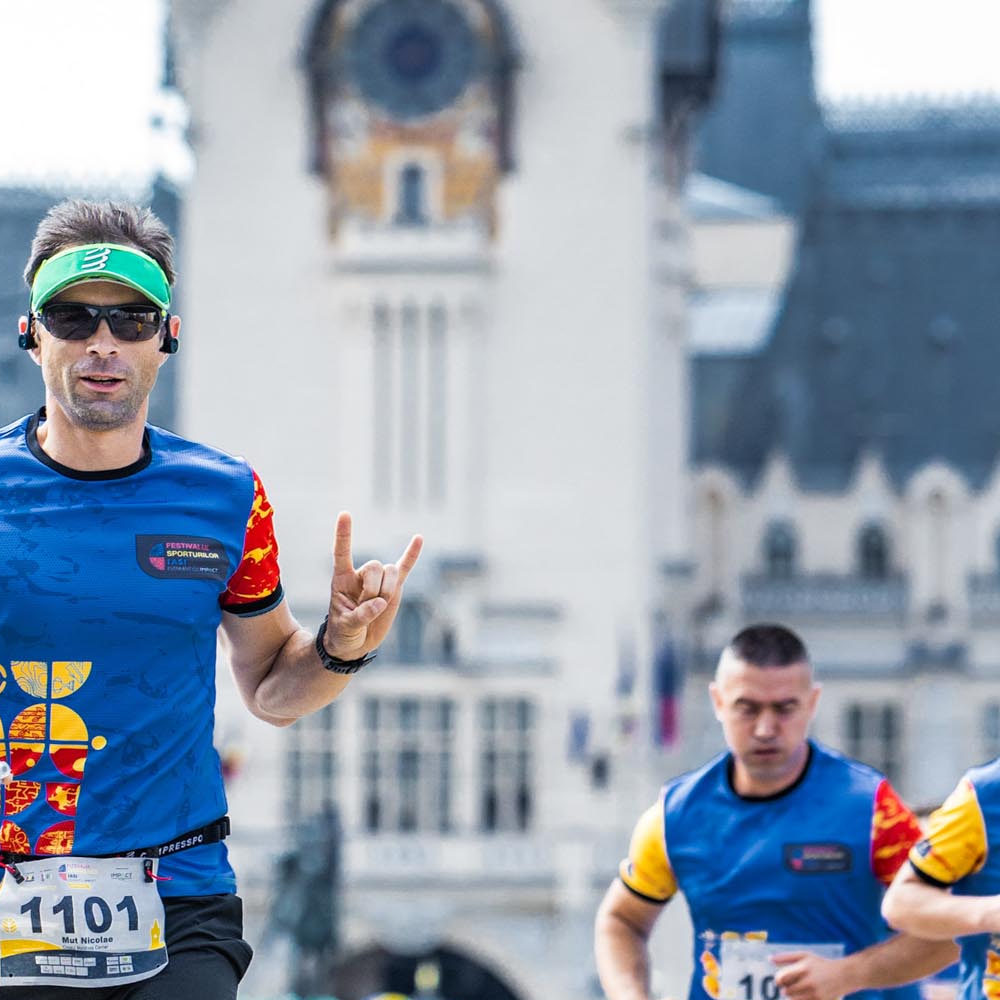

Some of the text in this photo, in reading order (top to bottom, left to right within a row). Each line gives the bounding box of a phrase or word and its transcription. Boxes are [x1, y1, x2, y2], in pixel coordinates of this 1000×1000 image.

[166, 550, 219, 559] SPORTURILOR
[20, 895, 139, 934] 1101
[62, 935, 113, 944] Mut Nicolae
